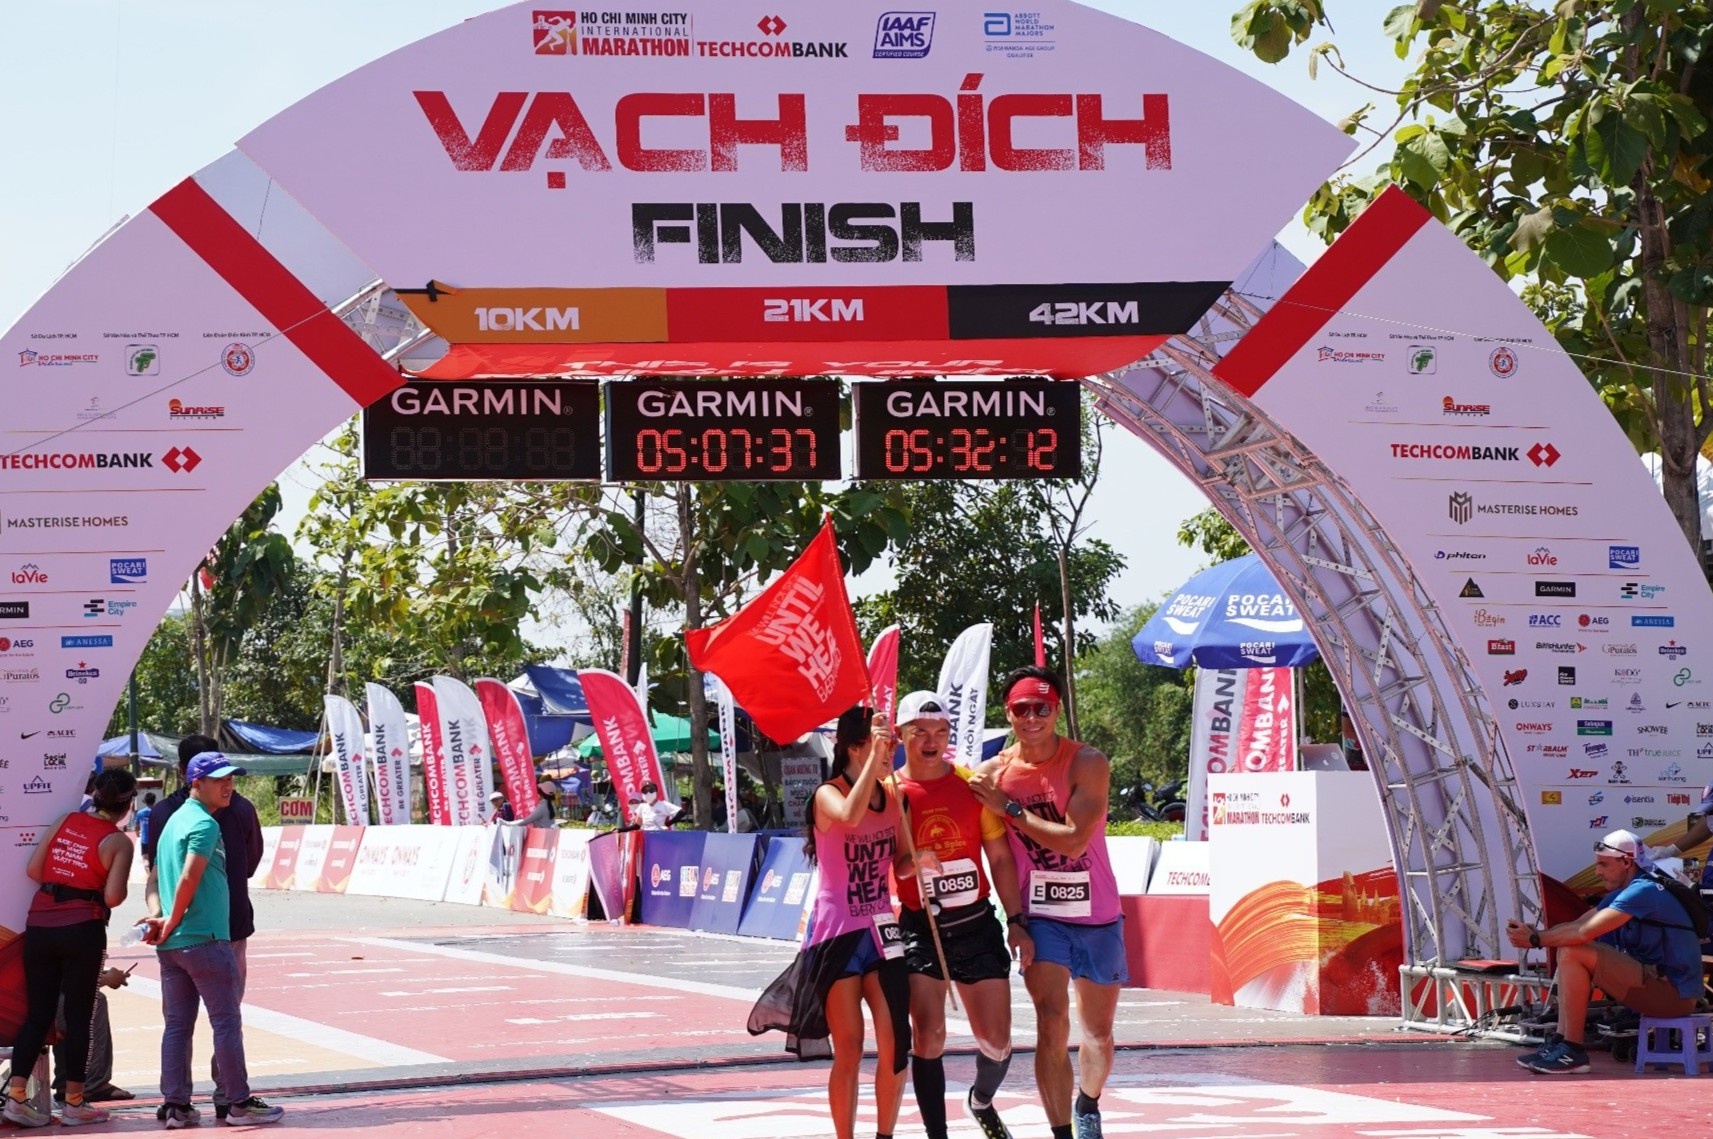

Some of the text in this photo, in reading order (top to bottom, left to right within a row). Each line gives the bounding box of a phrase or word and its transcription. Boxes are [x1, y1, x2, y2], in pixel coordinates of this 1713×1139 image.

[580, 12, 688, 25] HO CHI MINH CITY
[880, 16, 932, 32] IAAF
[581, 26, 689, 36] INTERNATIONAL
[880, 32, 926, 47] AIMS
[582, 38, 690, 57] MARATHON
[697, 41, 849, 59] TECHCOMBANK
[412, 72, 1172, 189] VẠCH ĐÍCH
[631, 201, 976, 264] FINISH
[764, 298, 864, 322] 21KM
[1029, 301, 1139, 325] 42KM
[474, 307, 580, 331] 10KM
[391, 388, 562, 415] GARMIN
[637, 391, 803, 418] GARMIN
[887, 391, 1044, 418] GARMIN
[637, 428, 816, 472] 05:07:37
[885, 428, 1058, 472] 05:32:12
[1391, 443, 1520, 461] TECHCOMBANK
[0, 452, 153, 470] TECHCOMBANK
[1477, 504, 1578, 516] MASTERISE HOMES
[7, 516, 129, 528] MASTERISE HOMES
[1540, 585, 1572, 593] GARMIN
[1641, 584, 1666, 592] Empire
[1641, 591, 1655, 599] City
[108, 601, 137, 609] Empire
[1173, 593, 1216, 608] POCARI
[1227, 594, 1291, 606] POCA
[108, 608, 125, 616] City
[753, 575, 824, 645] UNTIL
[1166, 604, 1206, 618] SWEAT
[1225, 605, 1294, 617] SWEAT
[1539, 615, 1561, 625] ACC
[1591, 617, 1609, 625] AEG
[13, 640, 34, 648] AEG
[76, 638, 107, 646] ANESSA
[779, 612, 826, 664] WE
[1516, 722, 1552, 731] ONWAYS
[395, 760, 405, 797] GREATER
[474, 758, 484, 800] GREATER
[1631, 794, 1654, 803] isentia
[281, 799, 313, 816] CƠM
[1227, 812, 1310, 825] MARATHON TECHCOMBANK
[660, 868, 671, 882] AEG
[847, 859, 880, 883] WE
[938, 875, 975, 893] 0858
[1034, 885, 1085, 899] E 0825
[884, 926, 902, 940] 082
